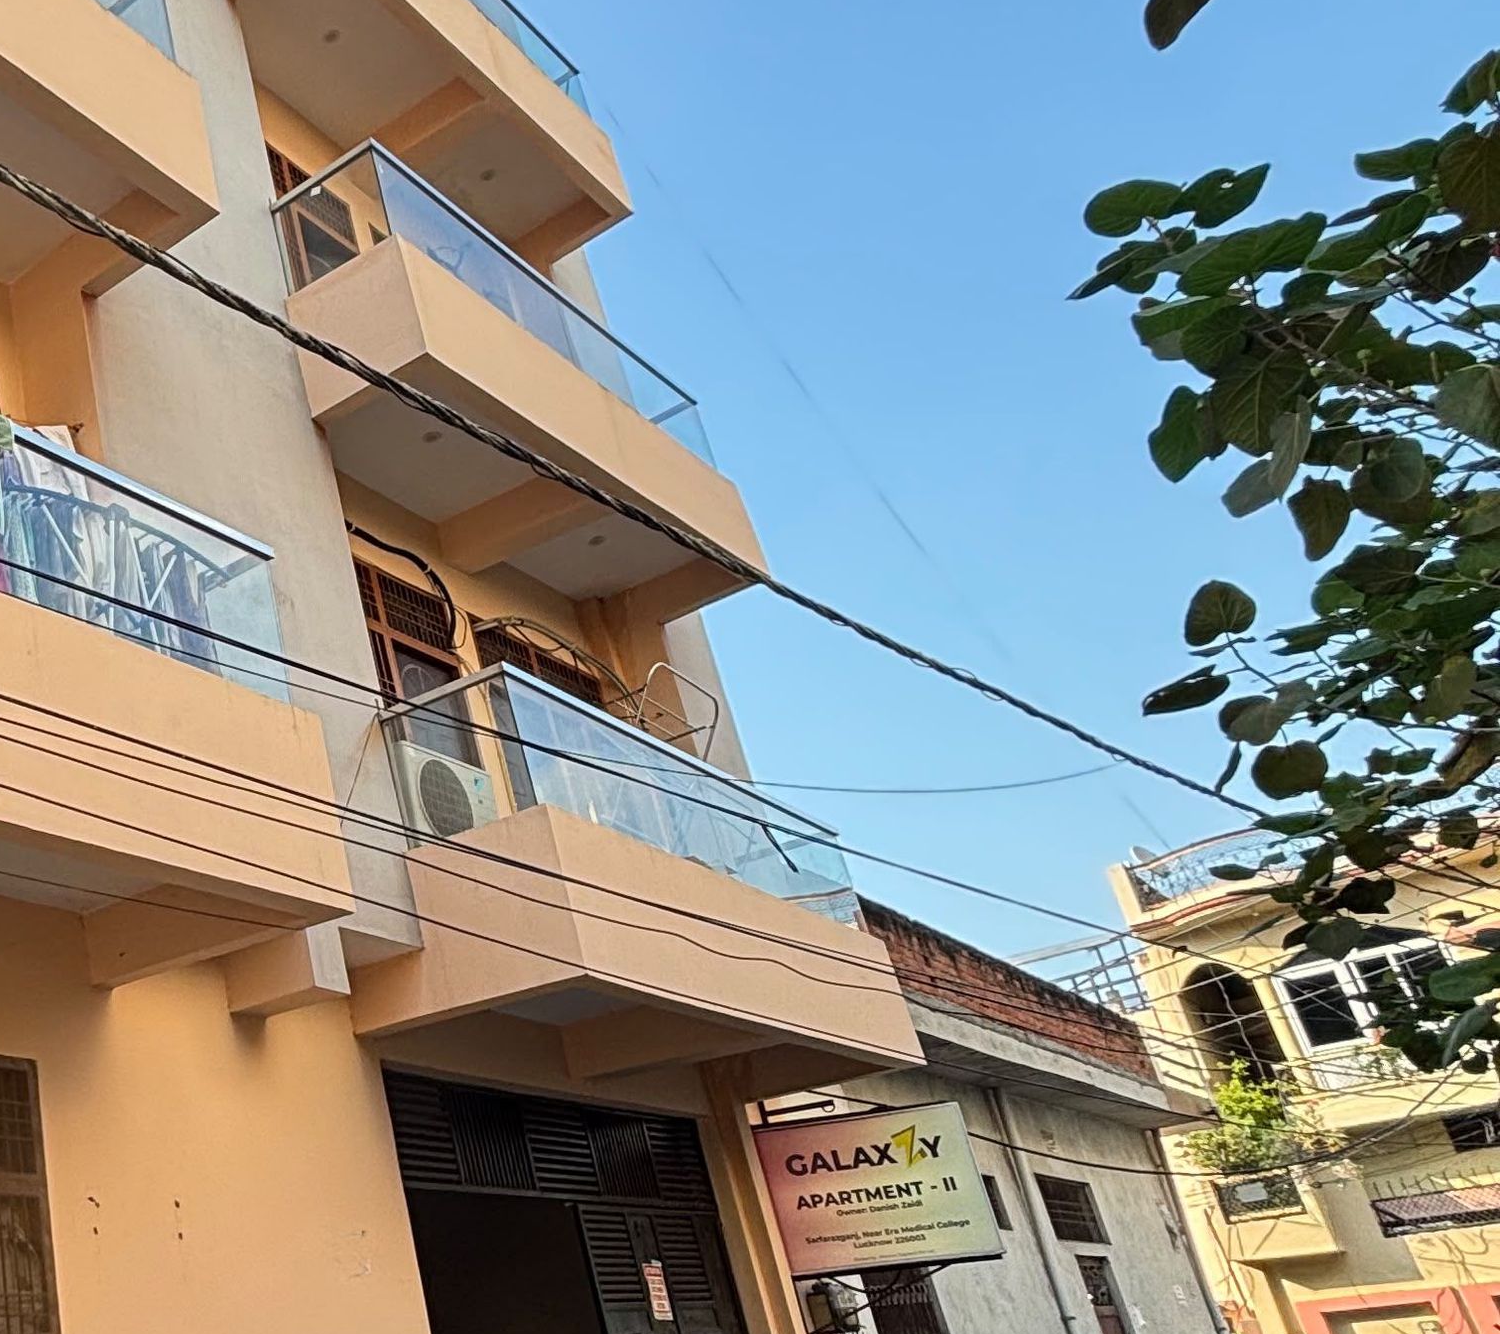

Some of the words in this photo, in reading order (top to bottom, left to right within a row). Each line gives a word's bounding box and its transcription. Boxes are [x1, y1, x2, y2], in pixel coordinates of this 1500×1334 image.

[797, 1181, 923, 1210] APARTMENT
[836, 1207, 868, 1217] Owner:
[869, 1203, 899, 1213] Danish
[901, 1199, 924, 1209] Zaidi
[862, 1230, 883, 1238] Near
[884, 1228, 900, 1236] Era
[900, 1223, 935, 1234] Medical
[936, 1218, 971, 1230] College
[853, 1239, 893, 1249] Lucknow
